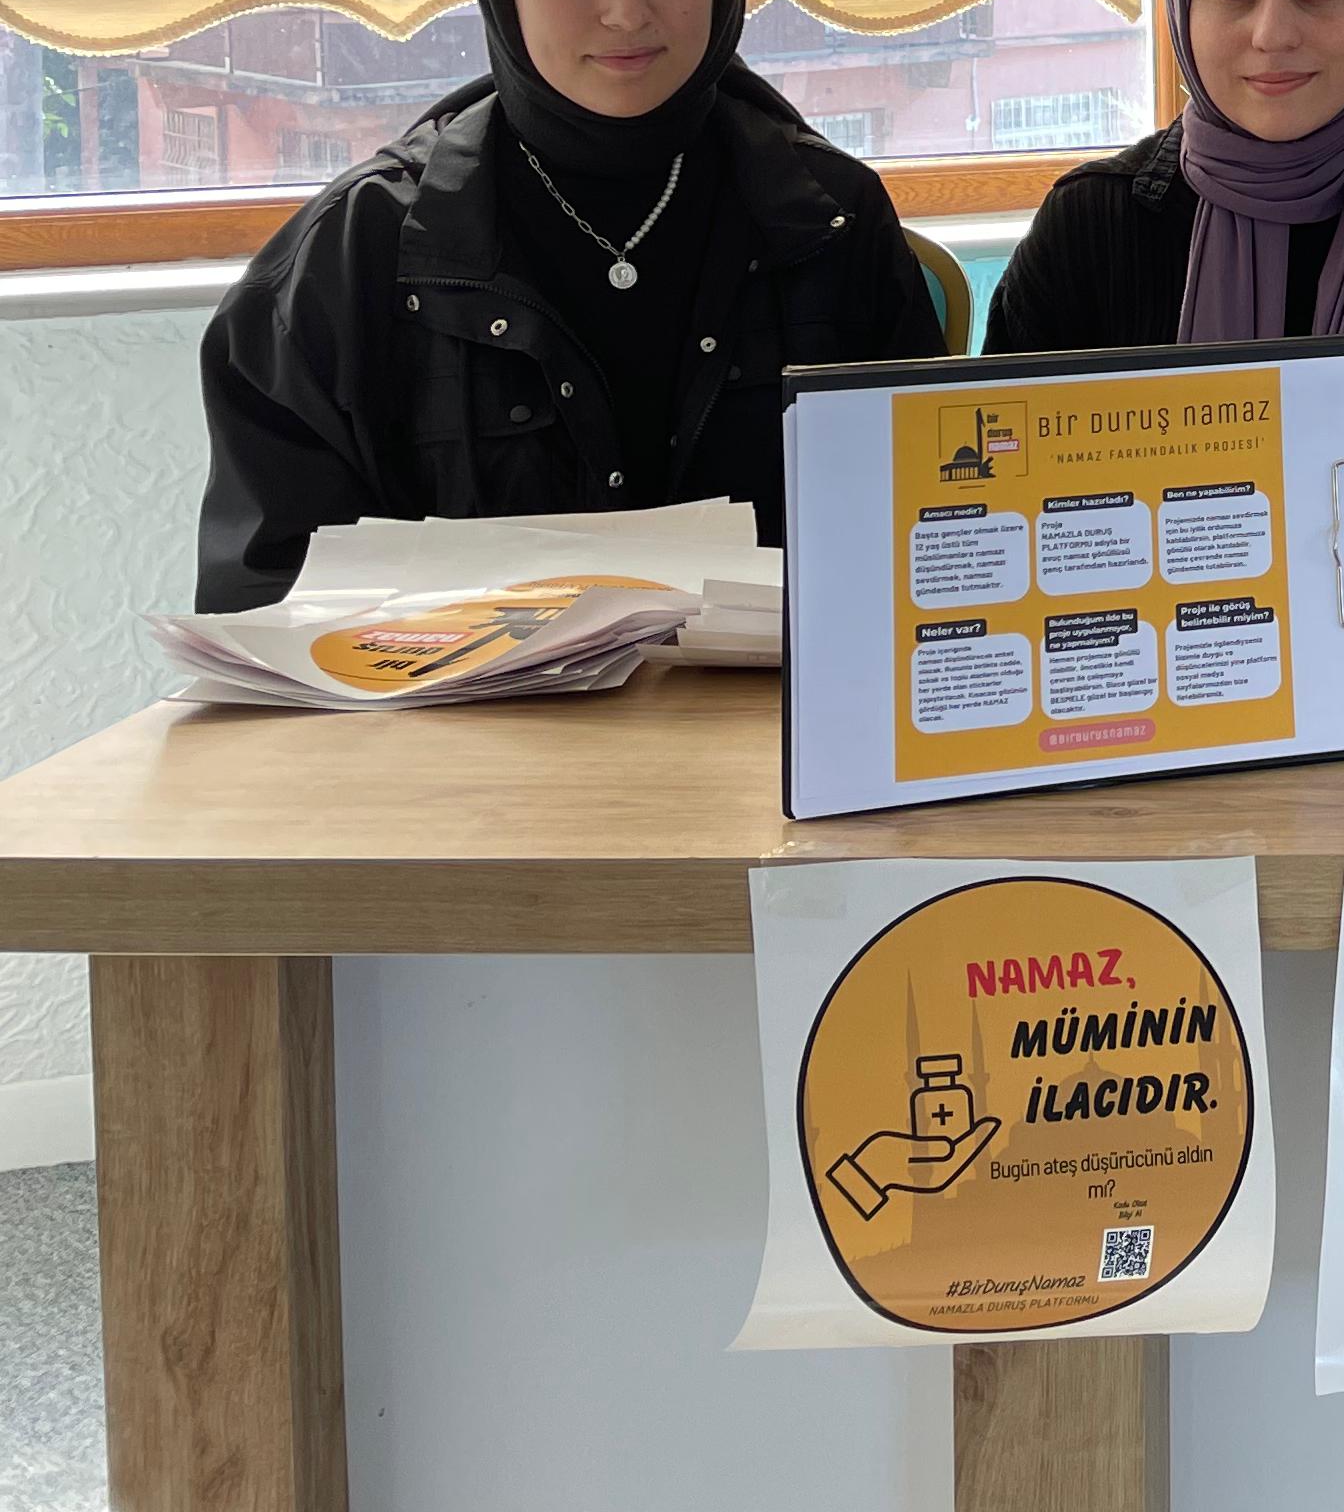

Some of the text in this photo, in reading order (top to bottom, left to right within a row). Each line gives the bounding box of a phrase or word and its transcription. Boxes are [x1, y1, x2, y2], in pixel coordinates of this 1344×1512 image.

[1183, 399, 1271, 427] namaz
[1109, 443, 1199, 460] FARKINDALIK
[1048, 495, 1129, 509] Kimler hazırladı?
[1181, 606, 1206, 616] Proje
[1222, 602, 1251, 613] görüş
[1181, 611, 1269, 627] belirtebilir miyim?
[921, 624, 981, 637] Neler var?
[966, 948, 1137, 999] NAMAZ,
[1010, 997, 1218, 1060] MÜMİNİN
[1025, 1072, 1219, 1125] İLACIDIR.
[990, 1146, 1213, 1182] Bugün ateş düşürücünü aldın
[1087, 1178, 1116, 1200] mı?
[945, 1273, 1087, 1300] #BirDuruşNamaz
[928, 1294, 1100, 1317] NAMAZLA DURUŞ PLATFORMU
